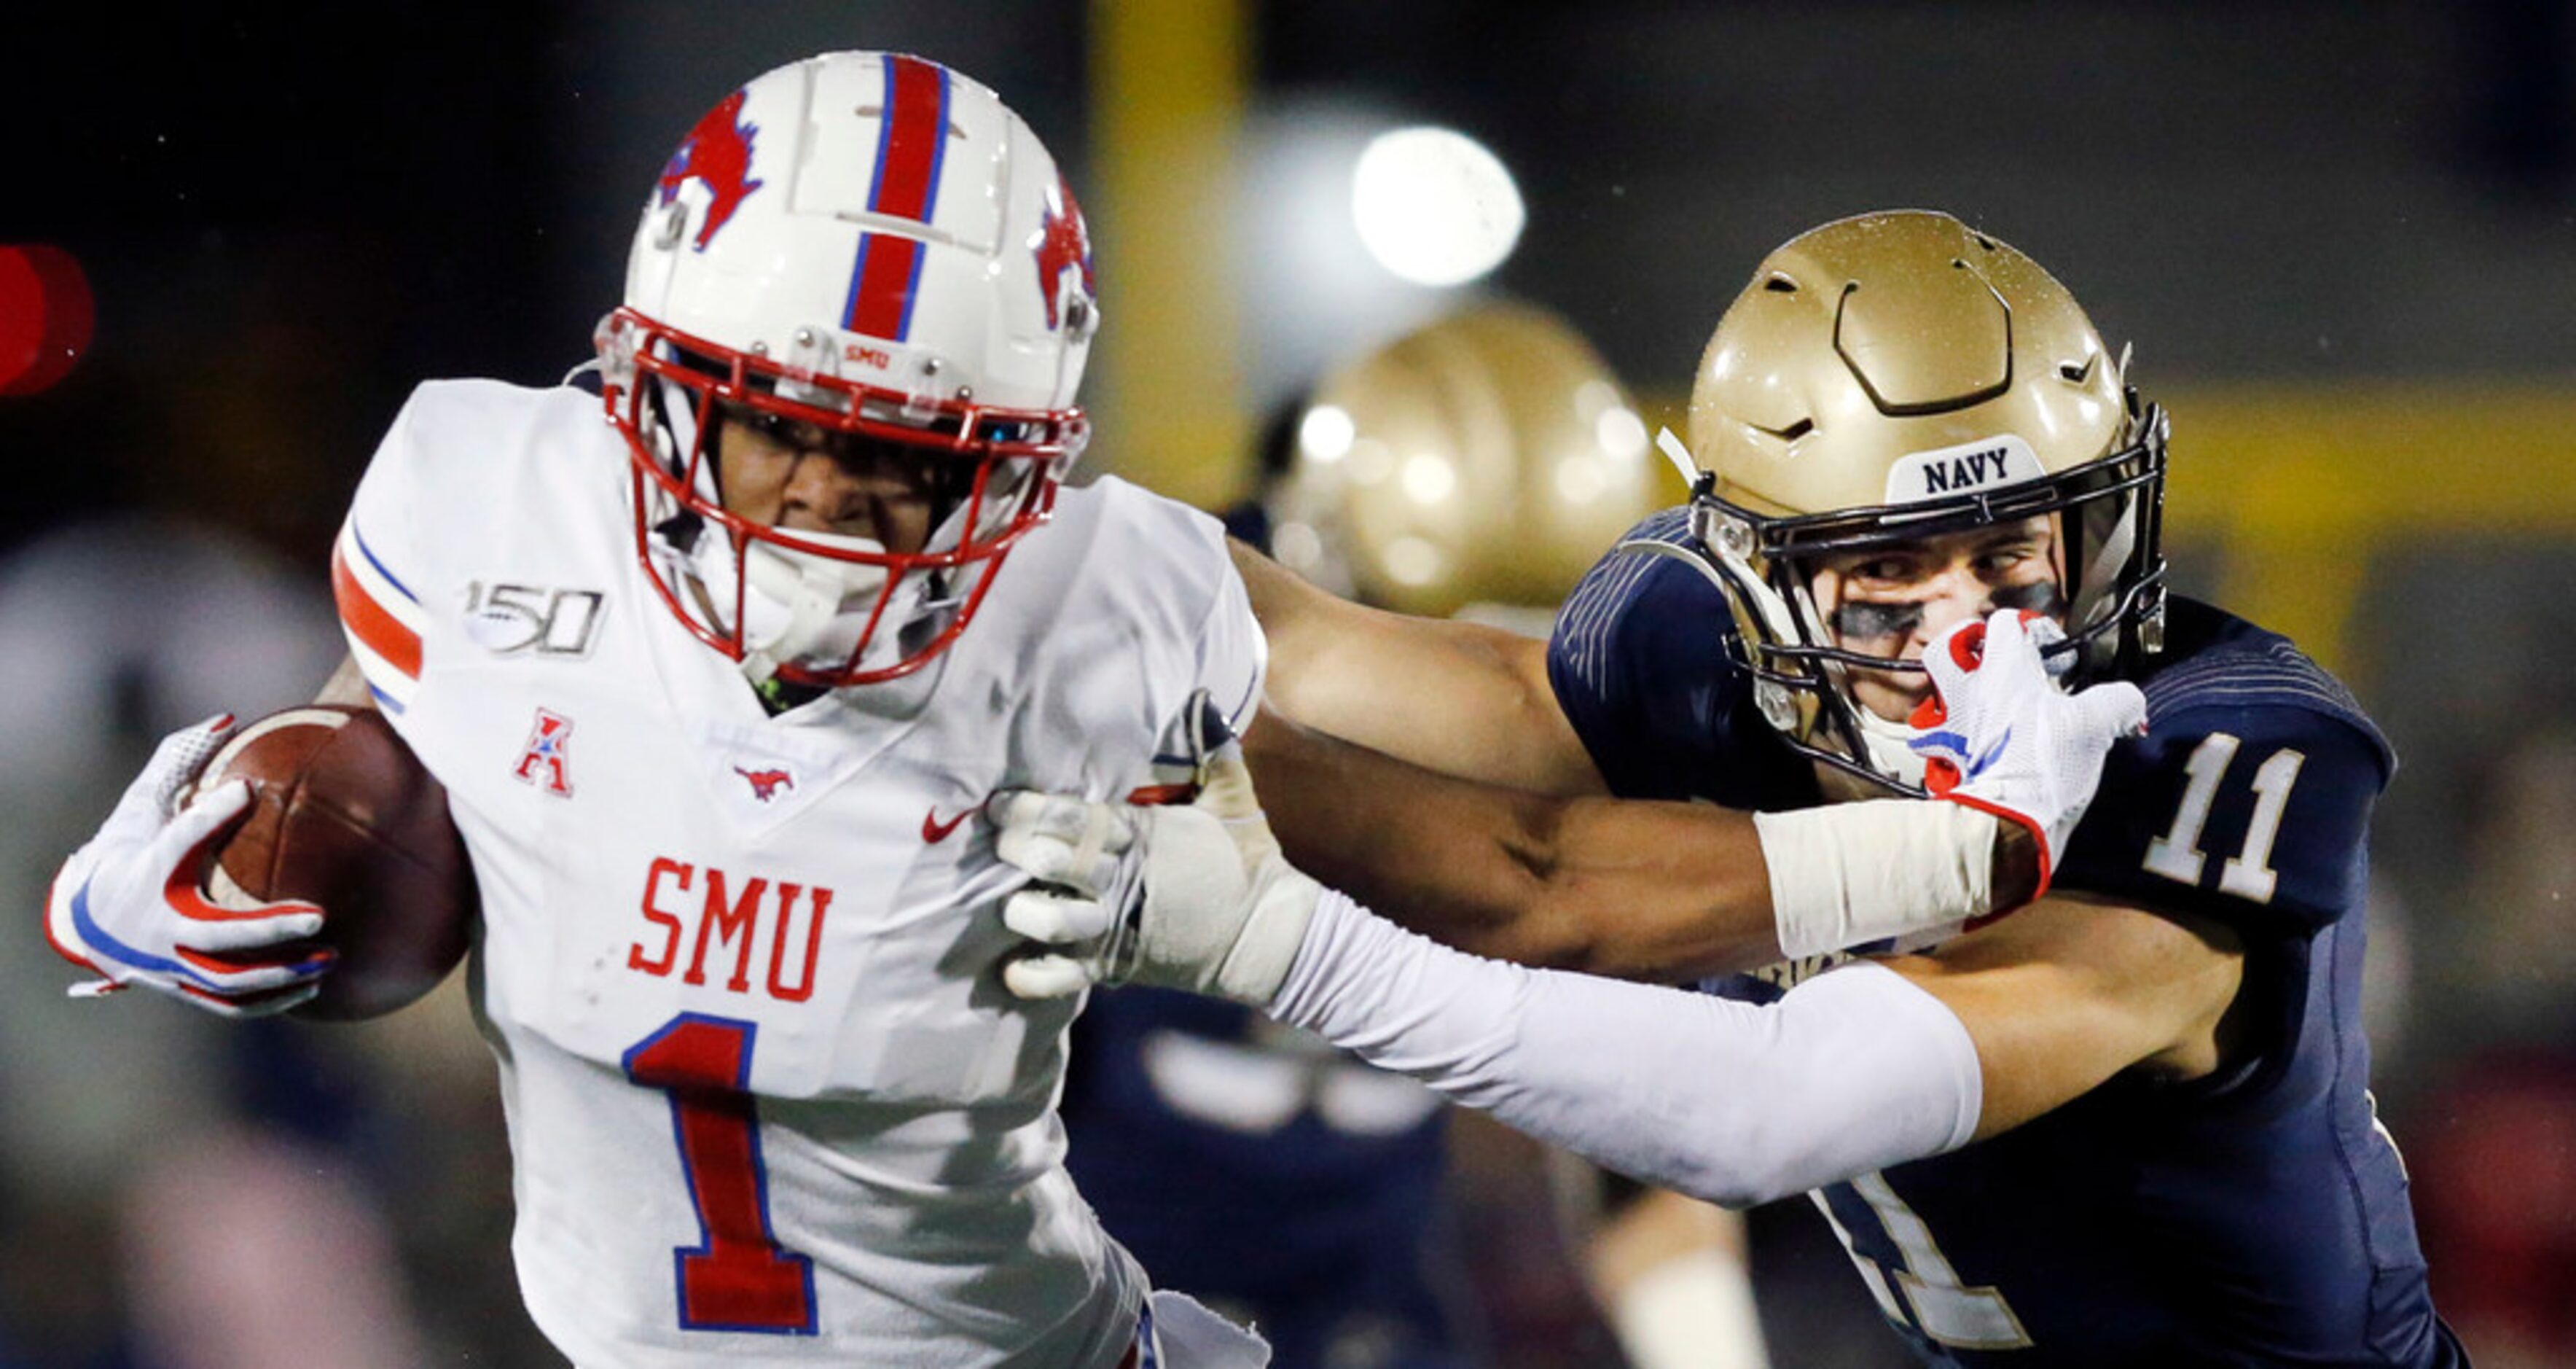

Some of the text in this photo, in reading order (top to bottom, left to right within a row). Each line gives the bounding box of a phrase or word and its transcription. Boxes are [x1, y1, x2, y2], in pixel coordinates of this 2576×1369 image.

[845, 344, 890, 370] SMU
[1922, 447, 2008, 494] NAVY
[463, 581, 604, 655] 150
[2142, 731, 2306, 905] 11
[627, 856, 834, 1003] SMU
[622, 1011, 820, 1336] 1
